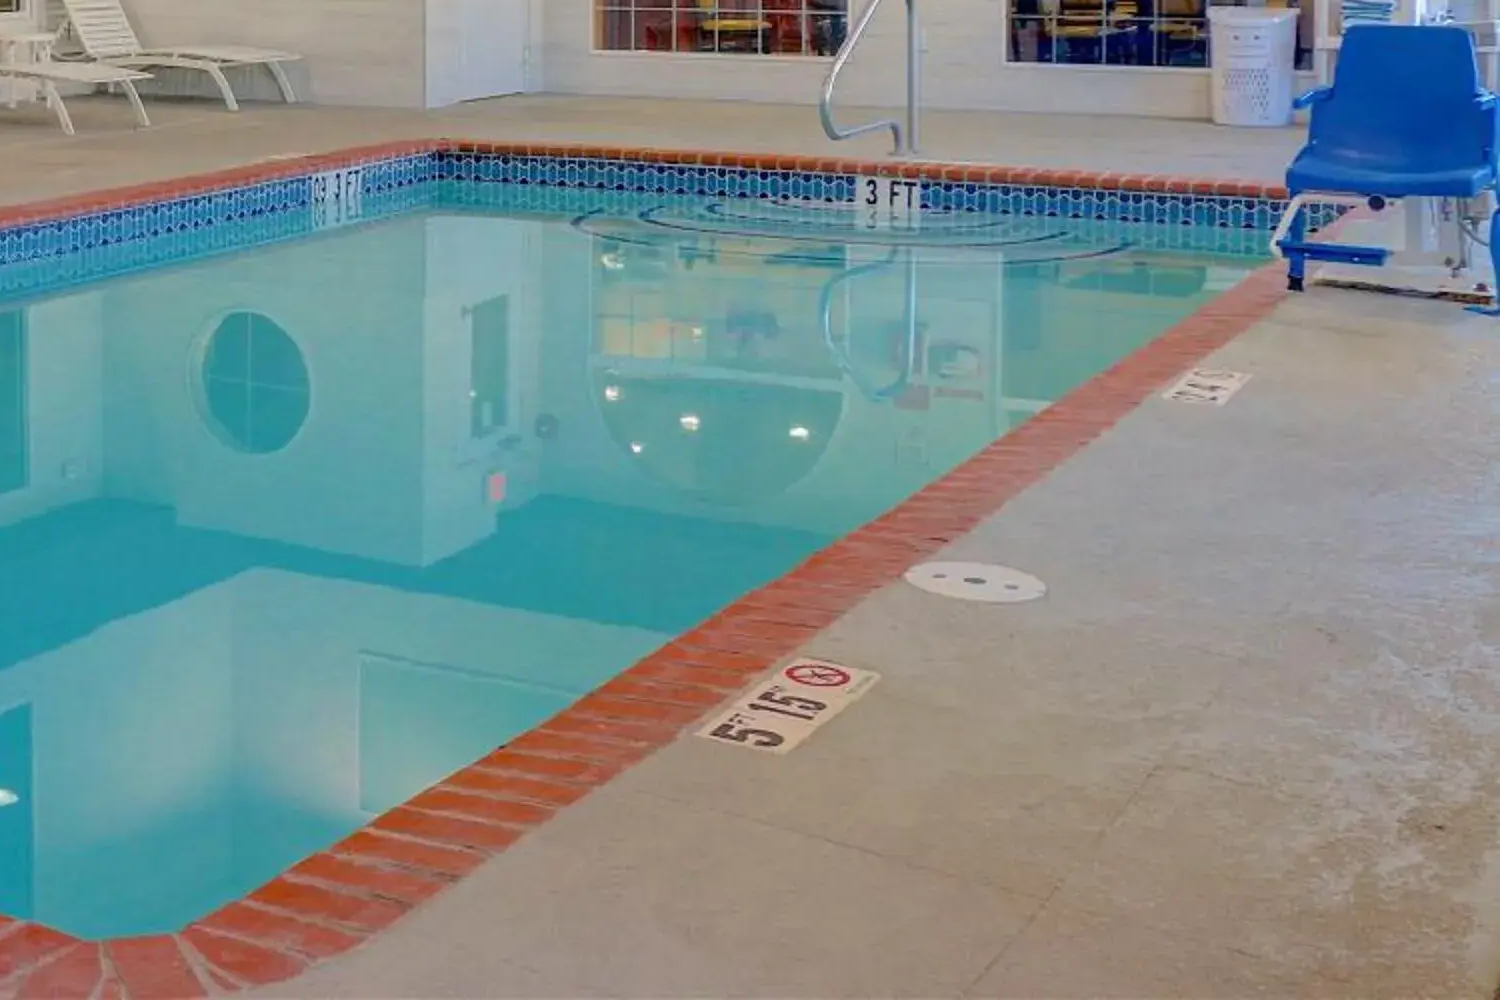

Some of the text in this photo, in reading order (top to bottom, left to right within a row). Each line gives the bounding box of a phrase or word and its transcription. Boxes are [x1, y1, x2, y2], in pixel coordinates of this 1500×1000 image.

[866, 179, 917, 209] 3 FT
[708, 723, 785, 748] 5
